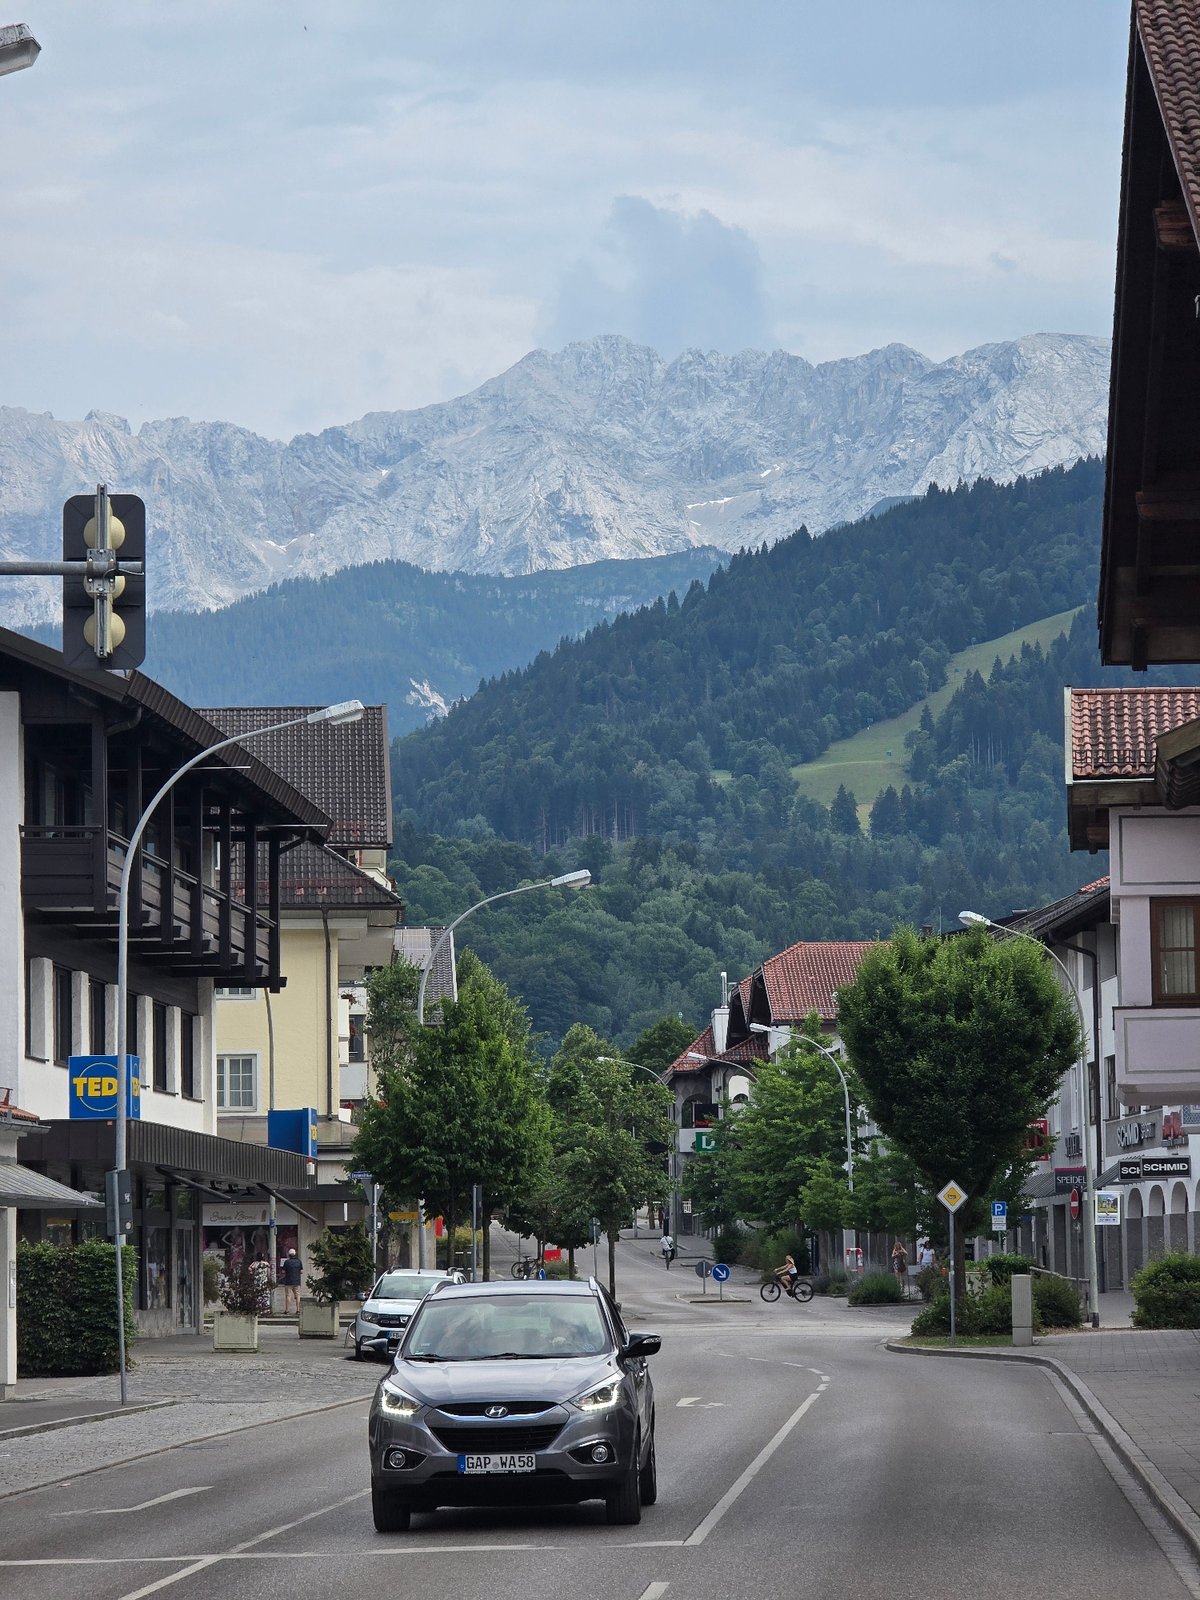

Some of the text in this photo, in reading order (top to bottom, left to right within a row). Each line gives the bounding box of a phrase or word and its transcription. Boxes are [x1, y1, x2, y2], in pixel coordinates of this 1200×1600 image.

[73, 1077, 118, 1097] TED
[1143, 1163, 1189, 1172] SCHMID
[1056, 1175, 1087, 1184] SPEIDEL
[994, 1203, 1003, 1216] P
[466, 1456, 491, 1470] GAP
